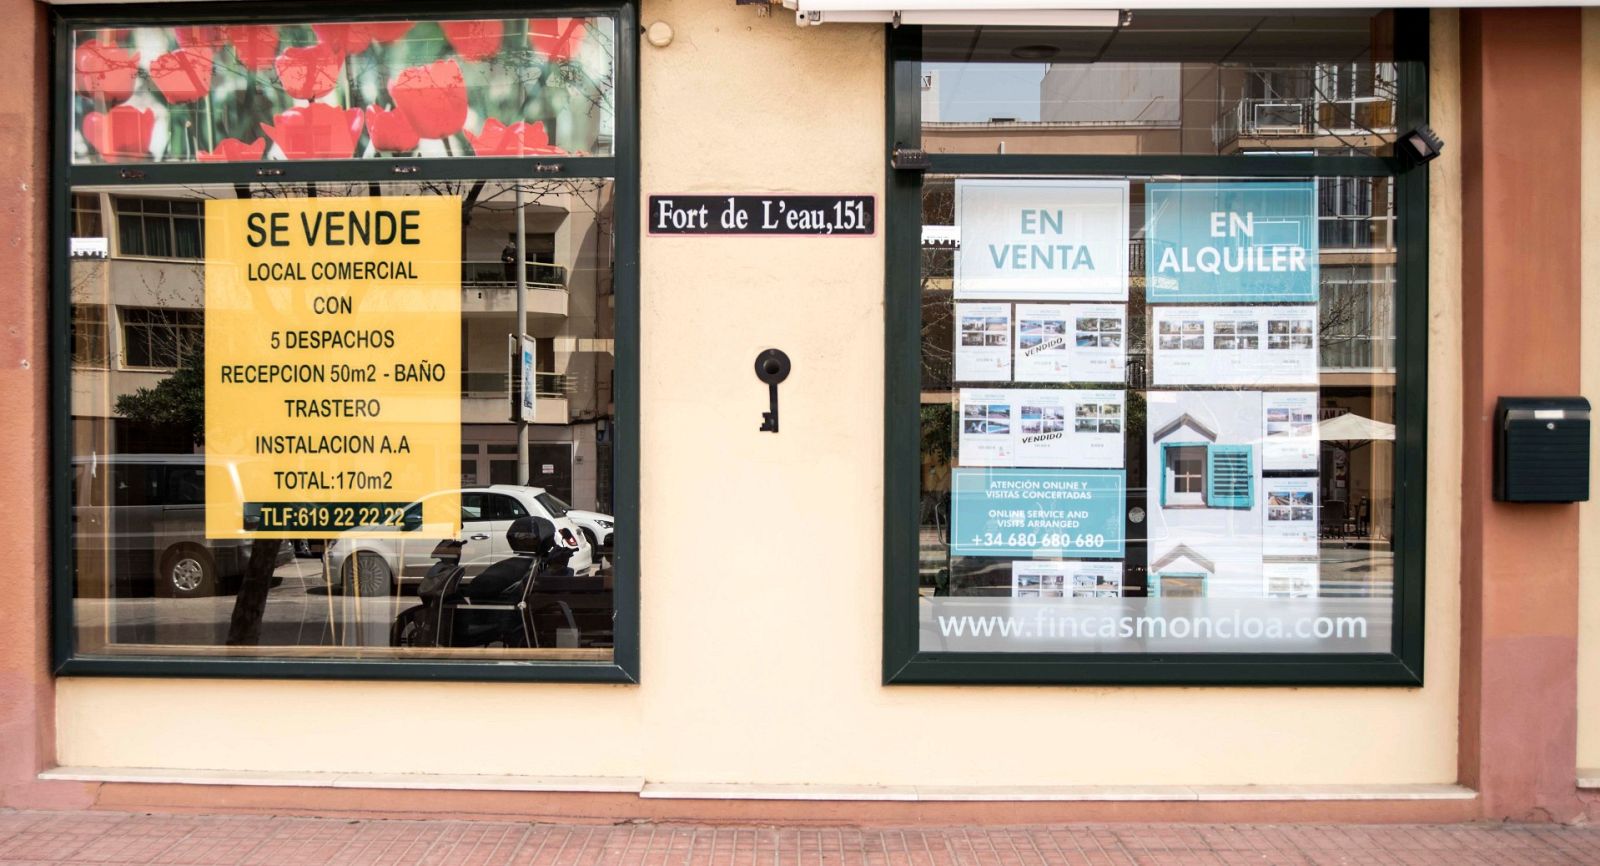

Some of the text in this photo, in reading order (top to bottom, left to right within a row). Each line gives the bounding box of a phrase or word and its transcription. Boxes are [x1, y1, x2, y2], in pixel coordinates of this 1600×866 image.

[657, 200, 708, 229] Fort
[721, 197, 748, 229] de
[1021, 209, 1063, 234] EN
[247, 210, 421, 247] SE VENDE
[1210, 211, 1254, 237] EN
[988, 244, 1095, 270] VENTA
[1159, 246, 1306, 274] ALQUILER
[248, 261, 417, 281] LOCAL COMERCIAL
[313, 296, 352, 314] CON
[271, 330, 395, 349] 5 DESPACHOS
[1024, 337, 1063, 357] VENDIDO
[221, 365, 324, 383] RECEPCION
[330, 365, 376, 382] 50m2
[395, 360, 446, 382] BAÑO
[285, 399, 381, 417] TRASTERO
[256, 435, 411, 453] INSTALACION A.A
[1022, 432, 1063, 444] VENDIDO
[274, 471, 393, 490] TOTAL:170m2
[990, 480, 1040, 489] ATENCIÓN
[1081, 482, 1088, 490] Y
[1022, 491, 1092, 499] CONCERTADAS
[260, 507, 405, 527] TLF:619 22 22 22
[989, 510, 1025, 518] ONLINE
[1068, 511, 1088, 519] AND
[997, 520, 1079, 528] VISITS ARRANGED
[972, 533, 1104, 547] +34 680 680 680
[938, 608, 1367, 639] www.fincasmoncloa.com
